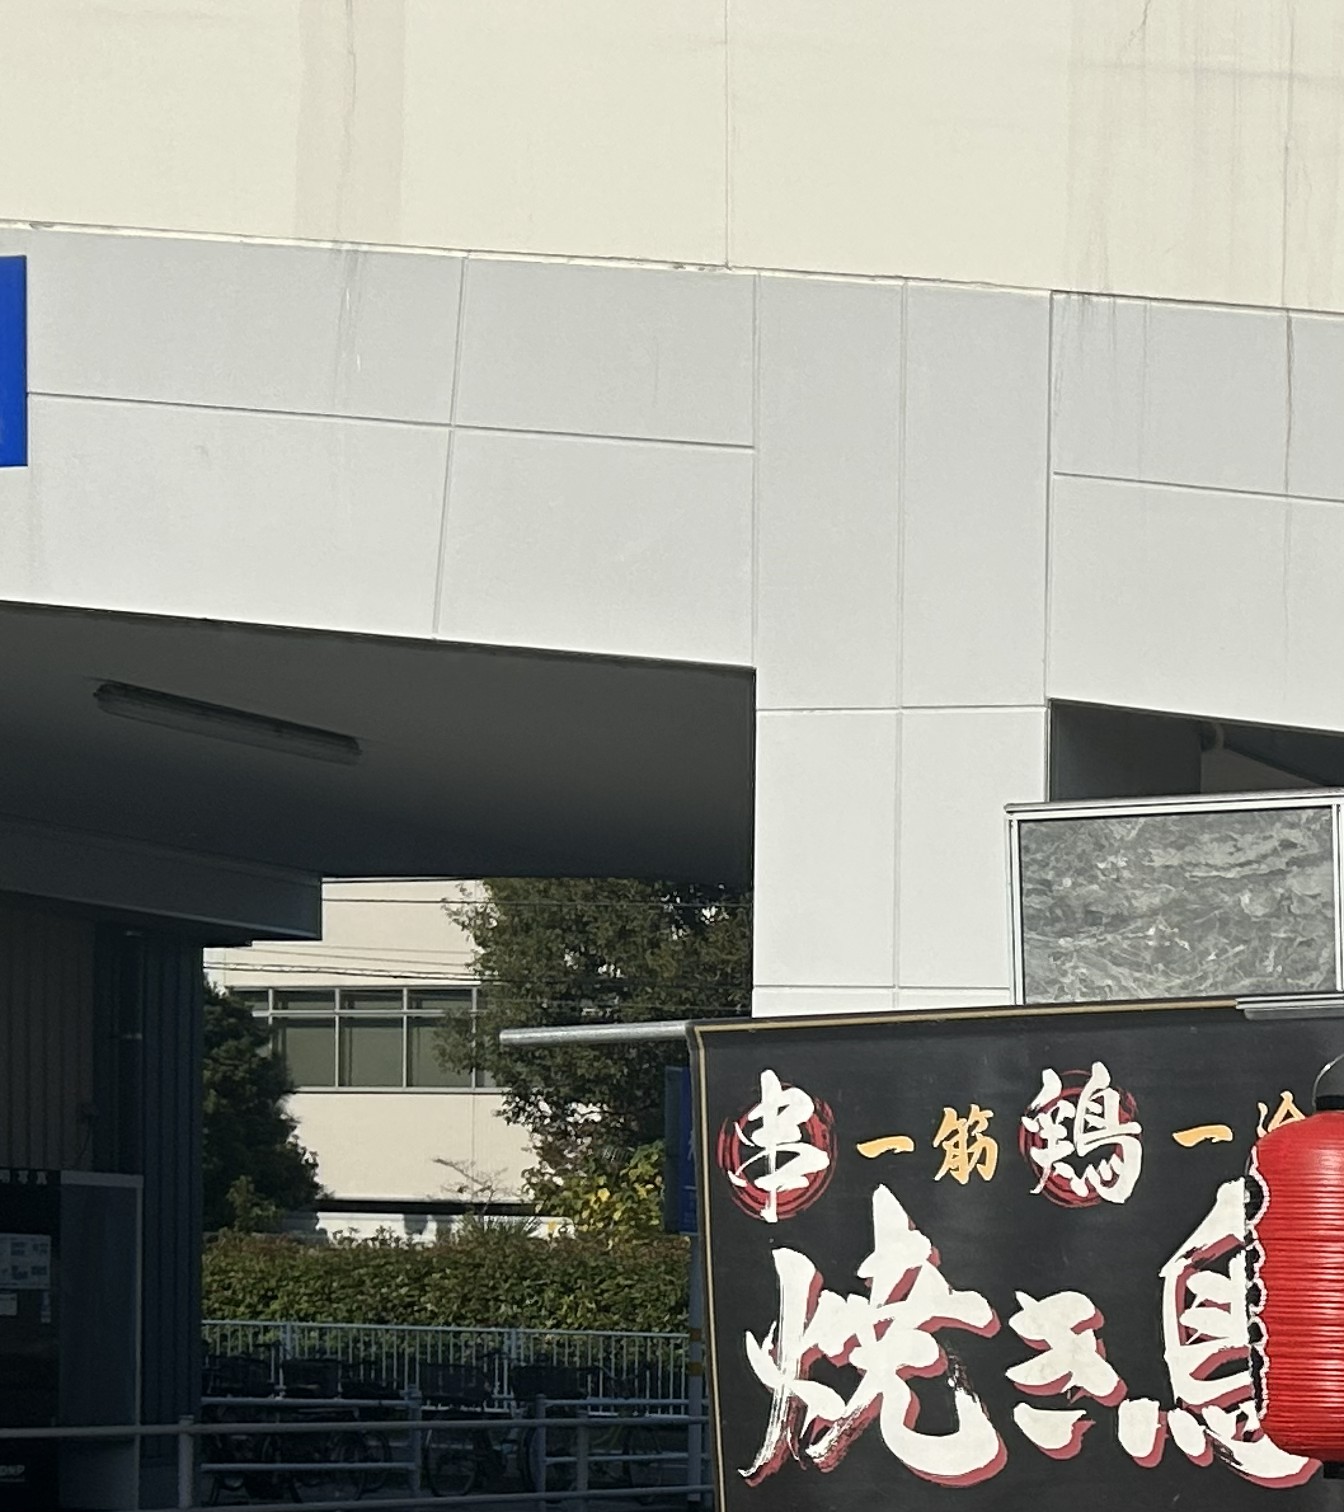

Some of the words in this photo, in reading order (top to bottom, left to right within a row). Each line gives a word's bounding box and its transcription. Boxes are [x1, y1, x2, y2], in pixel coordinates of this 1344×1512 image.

[727, 1061, 1307, 1222] 串一筋鶏一
